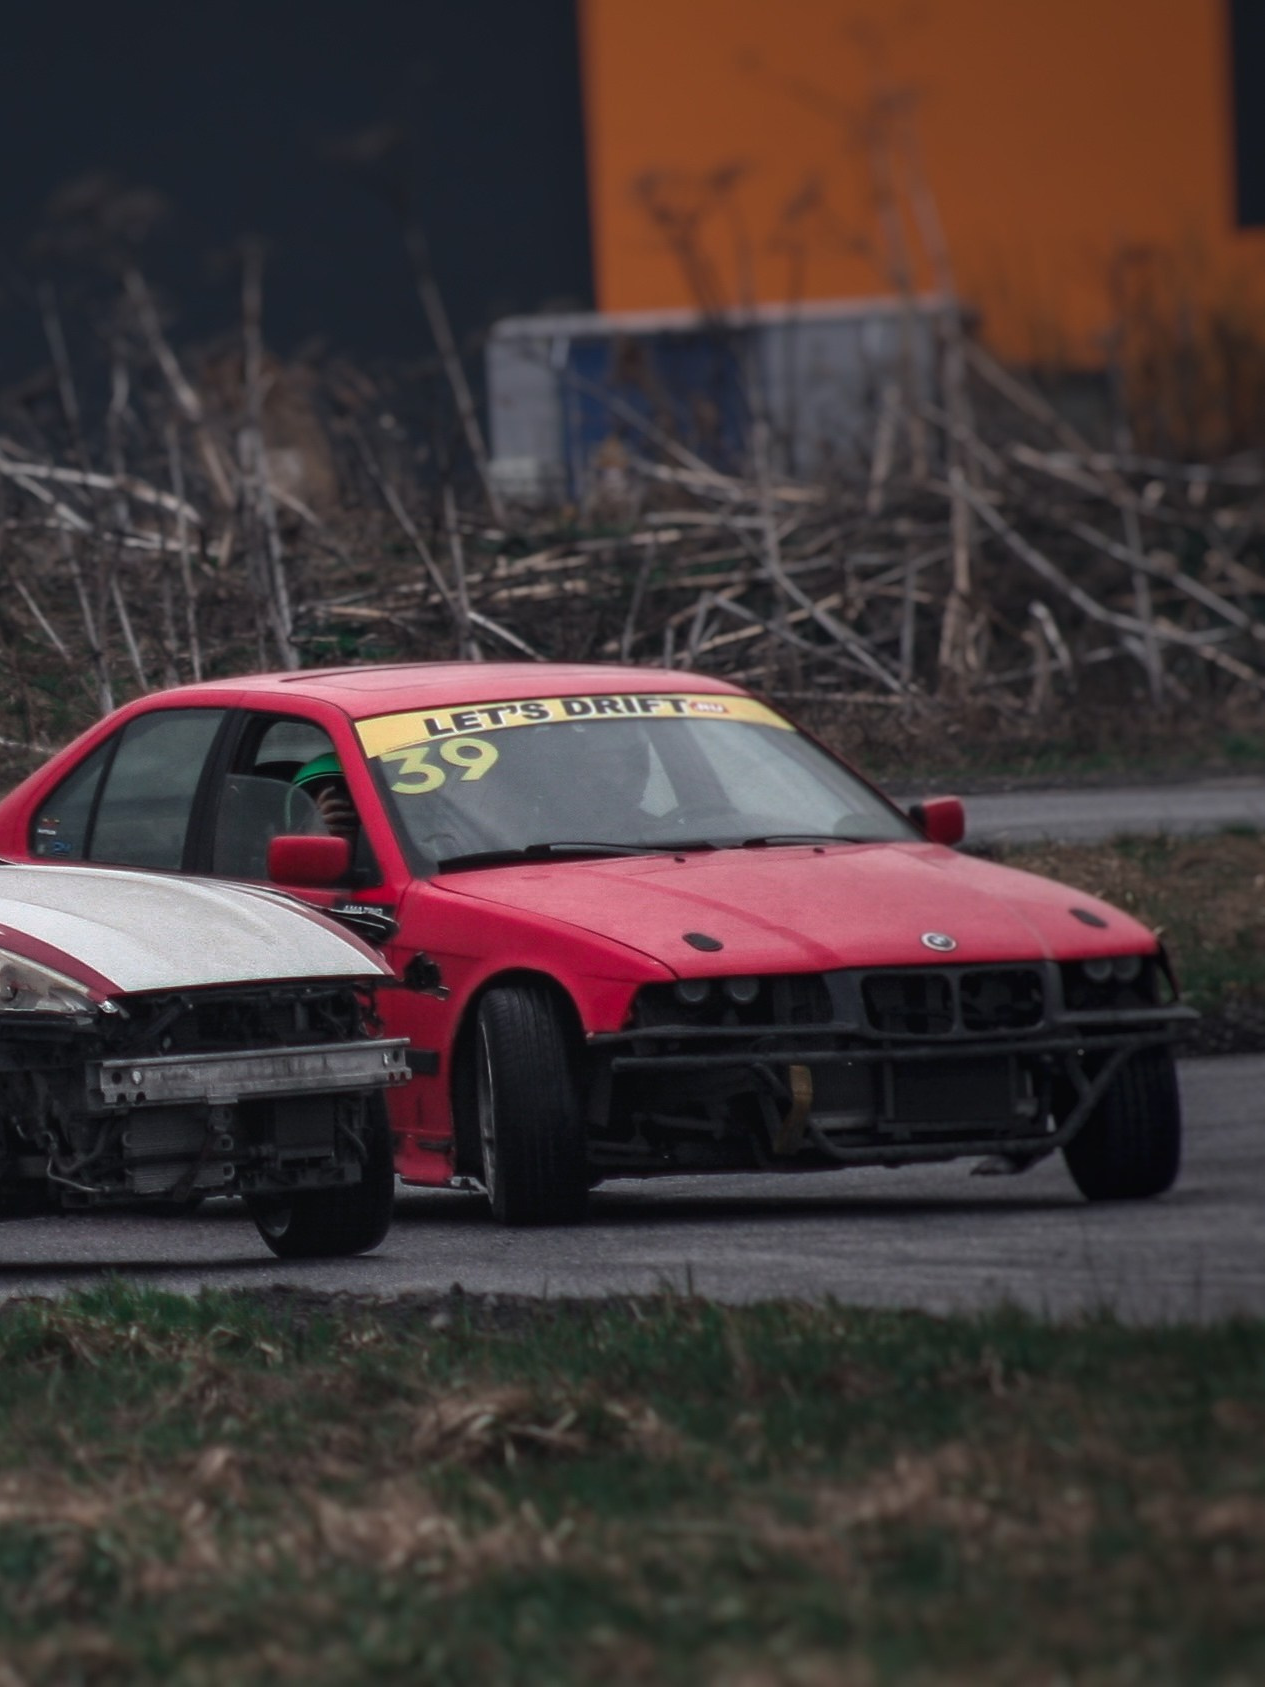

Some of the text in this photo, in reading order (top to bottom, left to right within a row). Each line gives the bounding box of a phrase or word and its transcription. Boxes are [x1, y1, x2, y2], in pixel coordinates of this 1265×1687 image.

[424, 703, 551, 737] LET'S
[560, 698, 688, 717] DRIFT
[380, 738, 499, 794] 39
